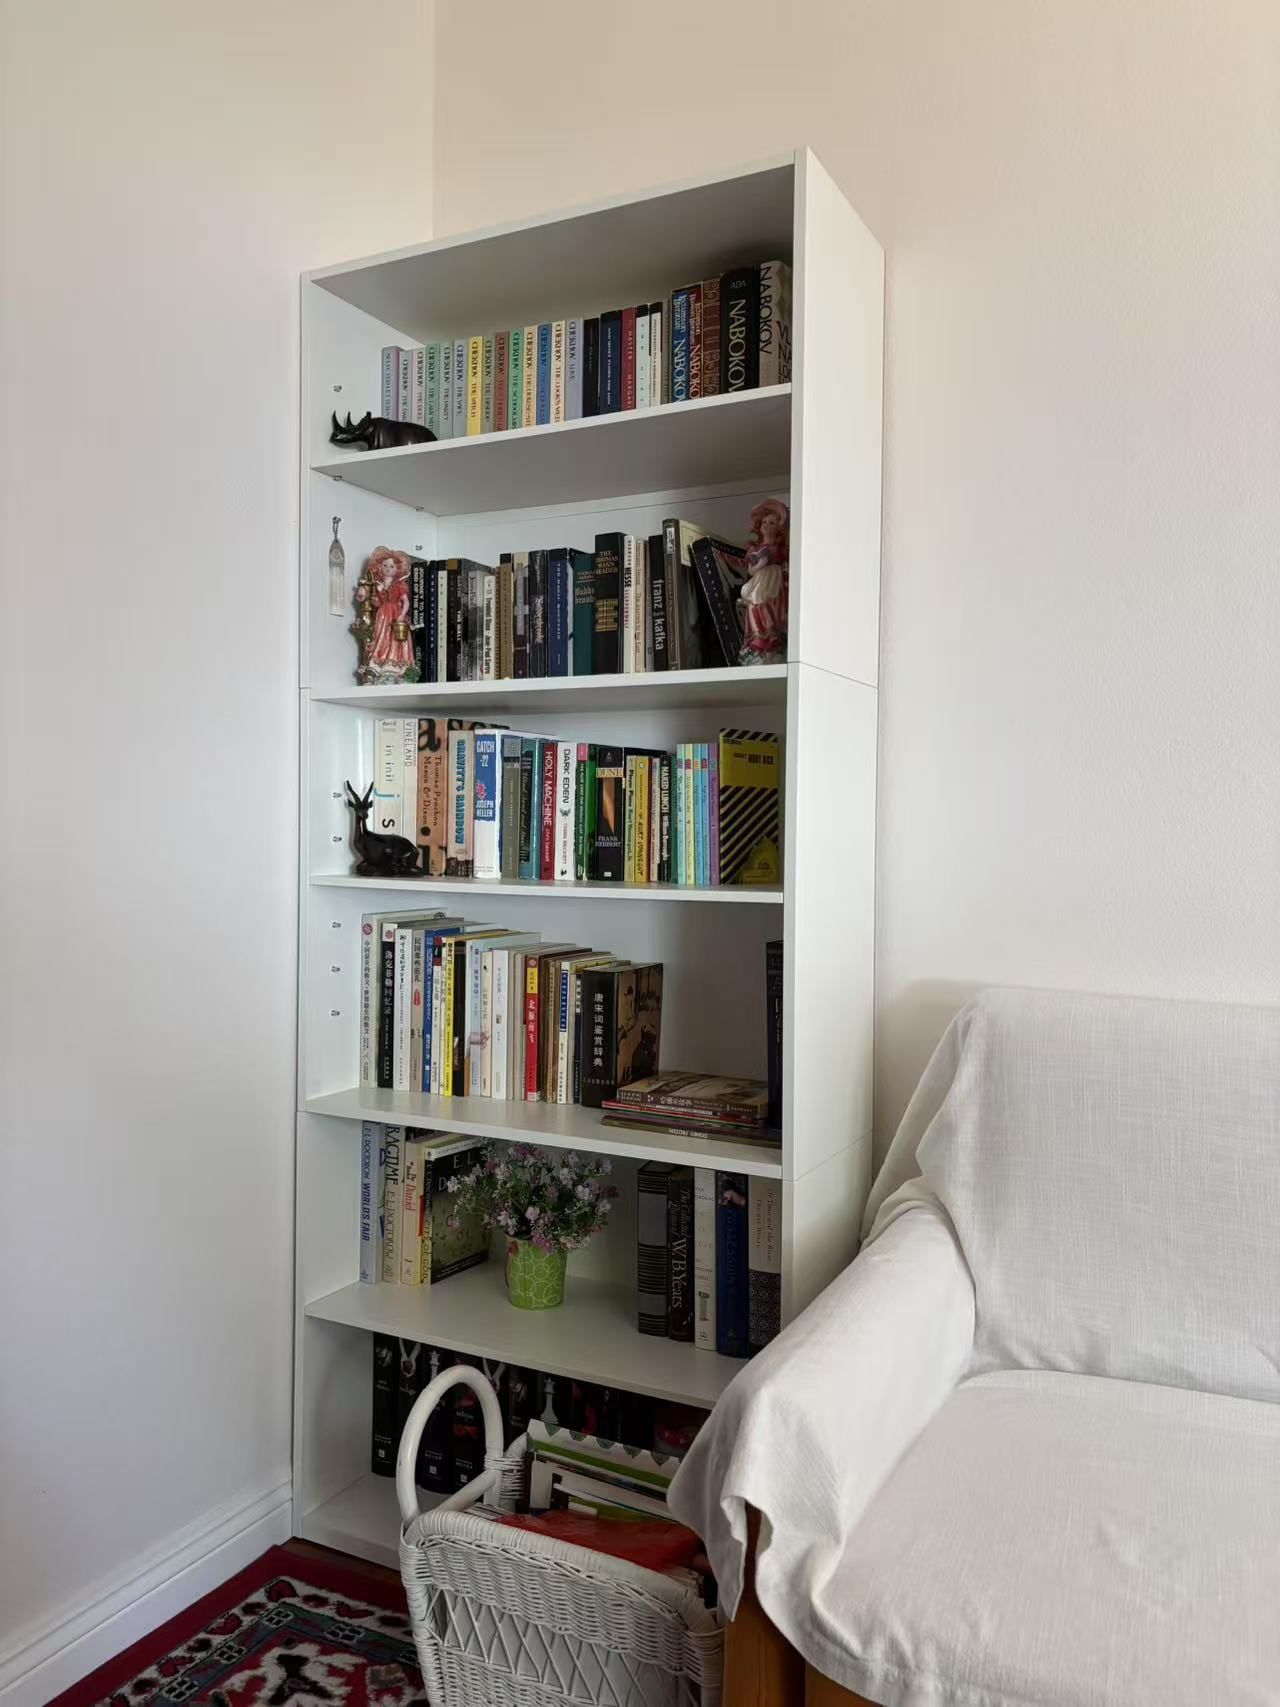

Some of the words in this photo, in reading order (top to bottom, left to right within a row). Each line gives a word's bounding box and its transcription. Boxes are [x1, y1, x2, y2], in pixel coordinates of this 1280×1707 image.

[730, 280, 750, 289] ADA
[759, 266, 773, 356] NABOKOV
[484, 340, 492, 378] CHEKHOV
[512, 332, 520, 370] CHEKHOV
[540, 328, 548, 366] CHEKHOV
[728, 299, 746, 393] NABOKOV
[416, 351, 424, 387] CHEKHOV
[456, 344, 464, 382] CHEKHOV
[624, 567, 632, 588] HESSE
[654, 578, 665, 609] franz
[654, 618, 666, 651] kafka
[404, 722, 414, 768] VINELAND
[476, 740, 495, 753] CATCH
[423, 756, 432, 784] Mason
[433, 756, 442, 788] Thomas
[456, 739, 466, 792] GRAVITY'S
[544, 751, 553, 778] HOLY
[563, 748, 571, 775] DARK
[596, 768, 623, 778] DUNE
[476, 800, 495, 808] JOSEPH
[544, 780, 552, 826] MACHINE
[562, 777, 570, 804] EDEN
[422, 800, 430, 826] Dixon
[432, 790, 441, 826] Pynchon
[455, 794, 466, 845] RAINBOW
[476, 808, 494, 818] HELLER
[593, 993, 604, 1067] 唐宋词鉴赏辞典
[364, 1140, 372, 1180] DOCTOROW
[386, 1126, 400, 1186] RAGTIME
[405, 1184, 417, 1212] Daniel
[362, 1222, 371, 1242] FAIR
[422, 1220, 430, 1242] CITY
[422, 1244, 430, 1255] OF
[422, 1259, 430, 1280] GOD
